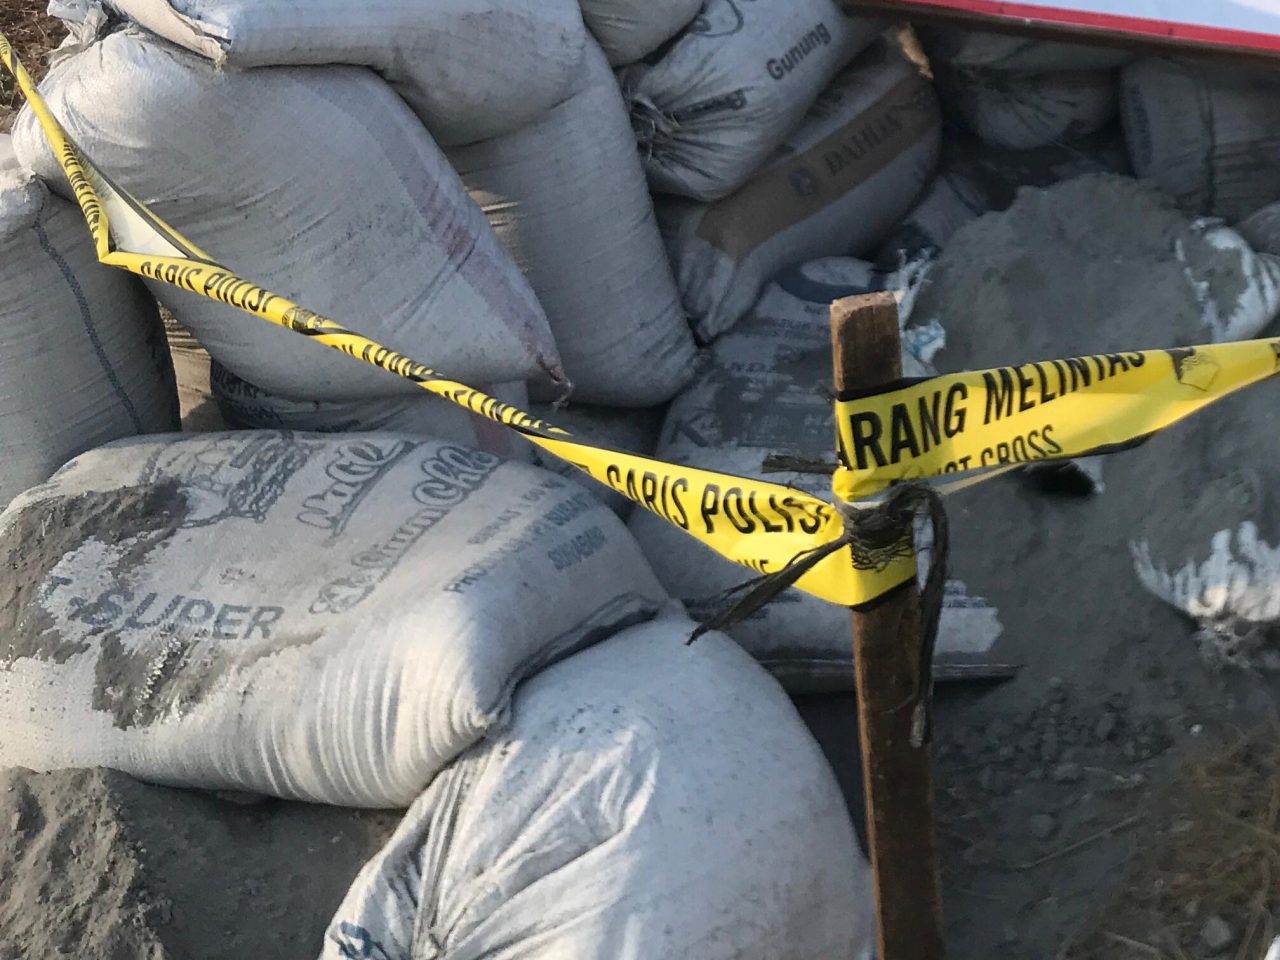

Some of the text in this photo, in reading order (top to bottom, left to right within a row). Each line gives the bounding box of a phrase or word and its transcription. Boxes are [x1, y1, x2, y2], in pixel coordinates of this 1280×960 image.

[766, 22, 832, 81] Gunung
[606, 464, 688, 530] GARIS
[700, 483, 834, 534] POLISI
[80, 590, 286, 641] SUPER
